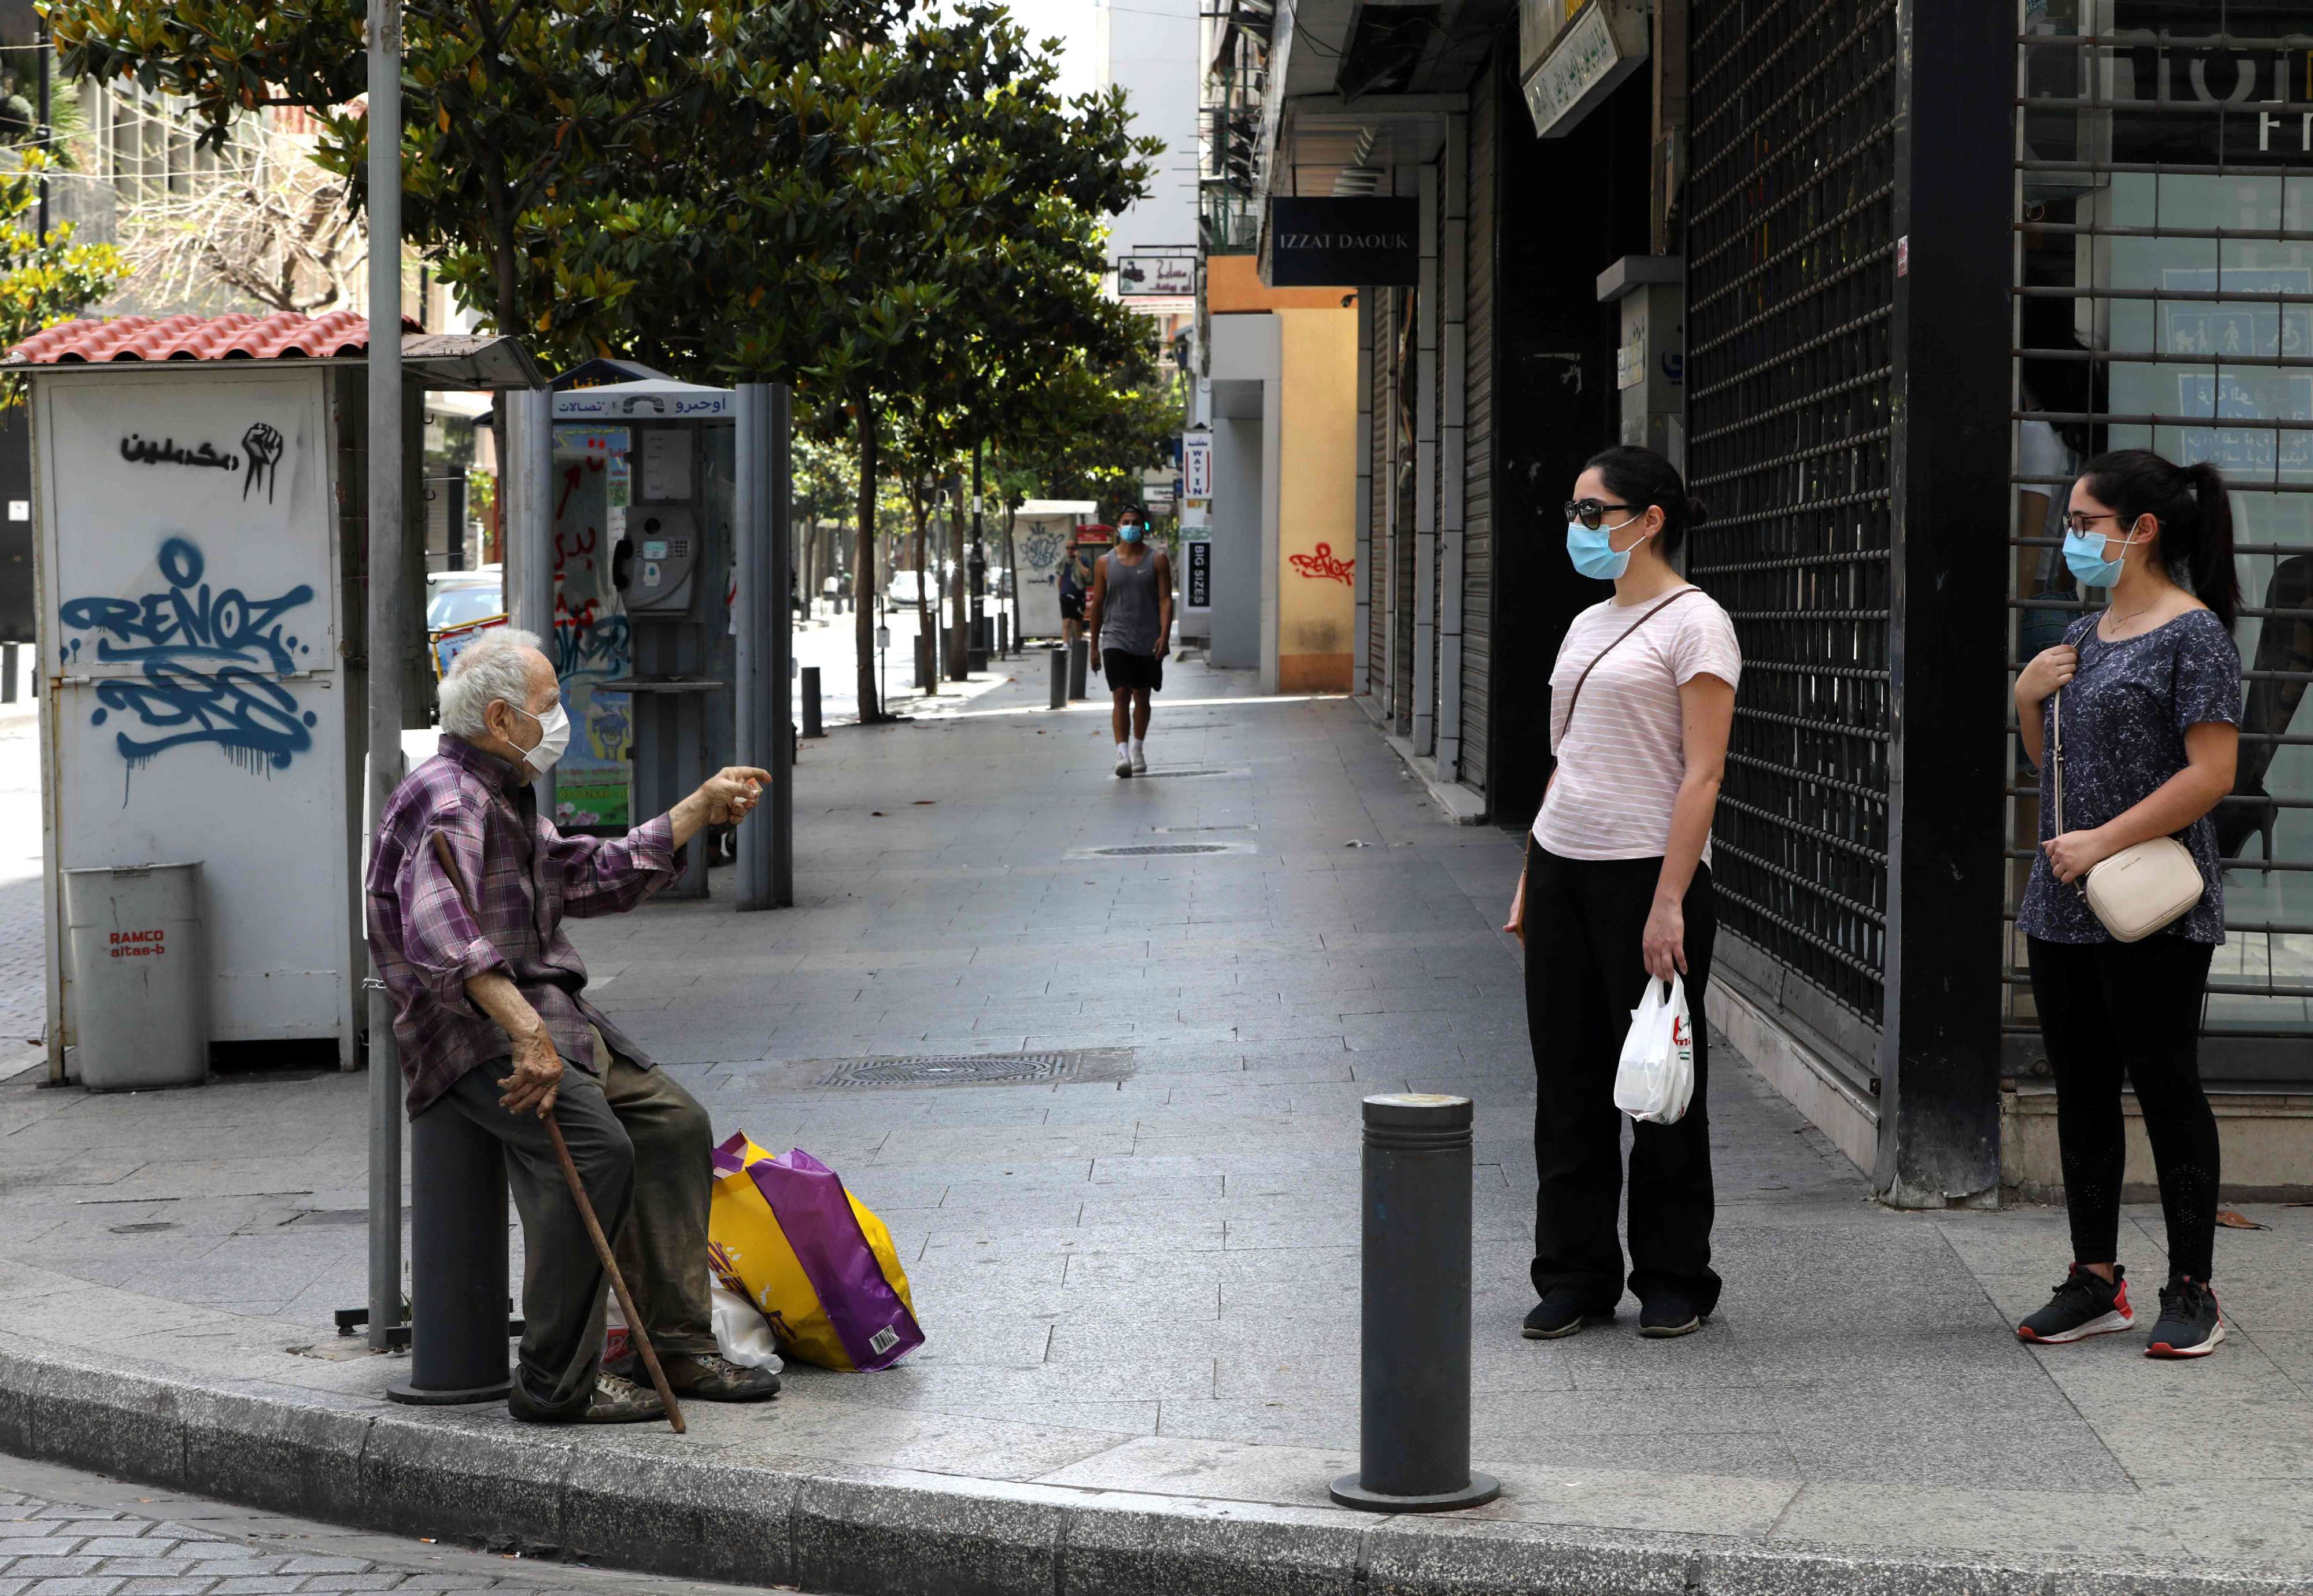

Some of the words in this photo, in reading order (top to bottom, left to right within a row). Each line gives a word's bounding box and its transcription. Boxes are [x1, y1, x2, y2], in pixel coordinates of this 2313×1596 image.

[1280, 234, 1333, 248] IZZAT
[1339, 234, 1408, 248] DAOUK
[121, 434, 239, 471] مكملين
[1192, 450, 1202, 473] WAY
[1193, 478, 1202, 496] IN
[1194, 545, 1204, 566] BIG
[1194, 570, 1204, 604] SIZES
[110, 930, 164, 944] RAMCO
